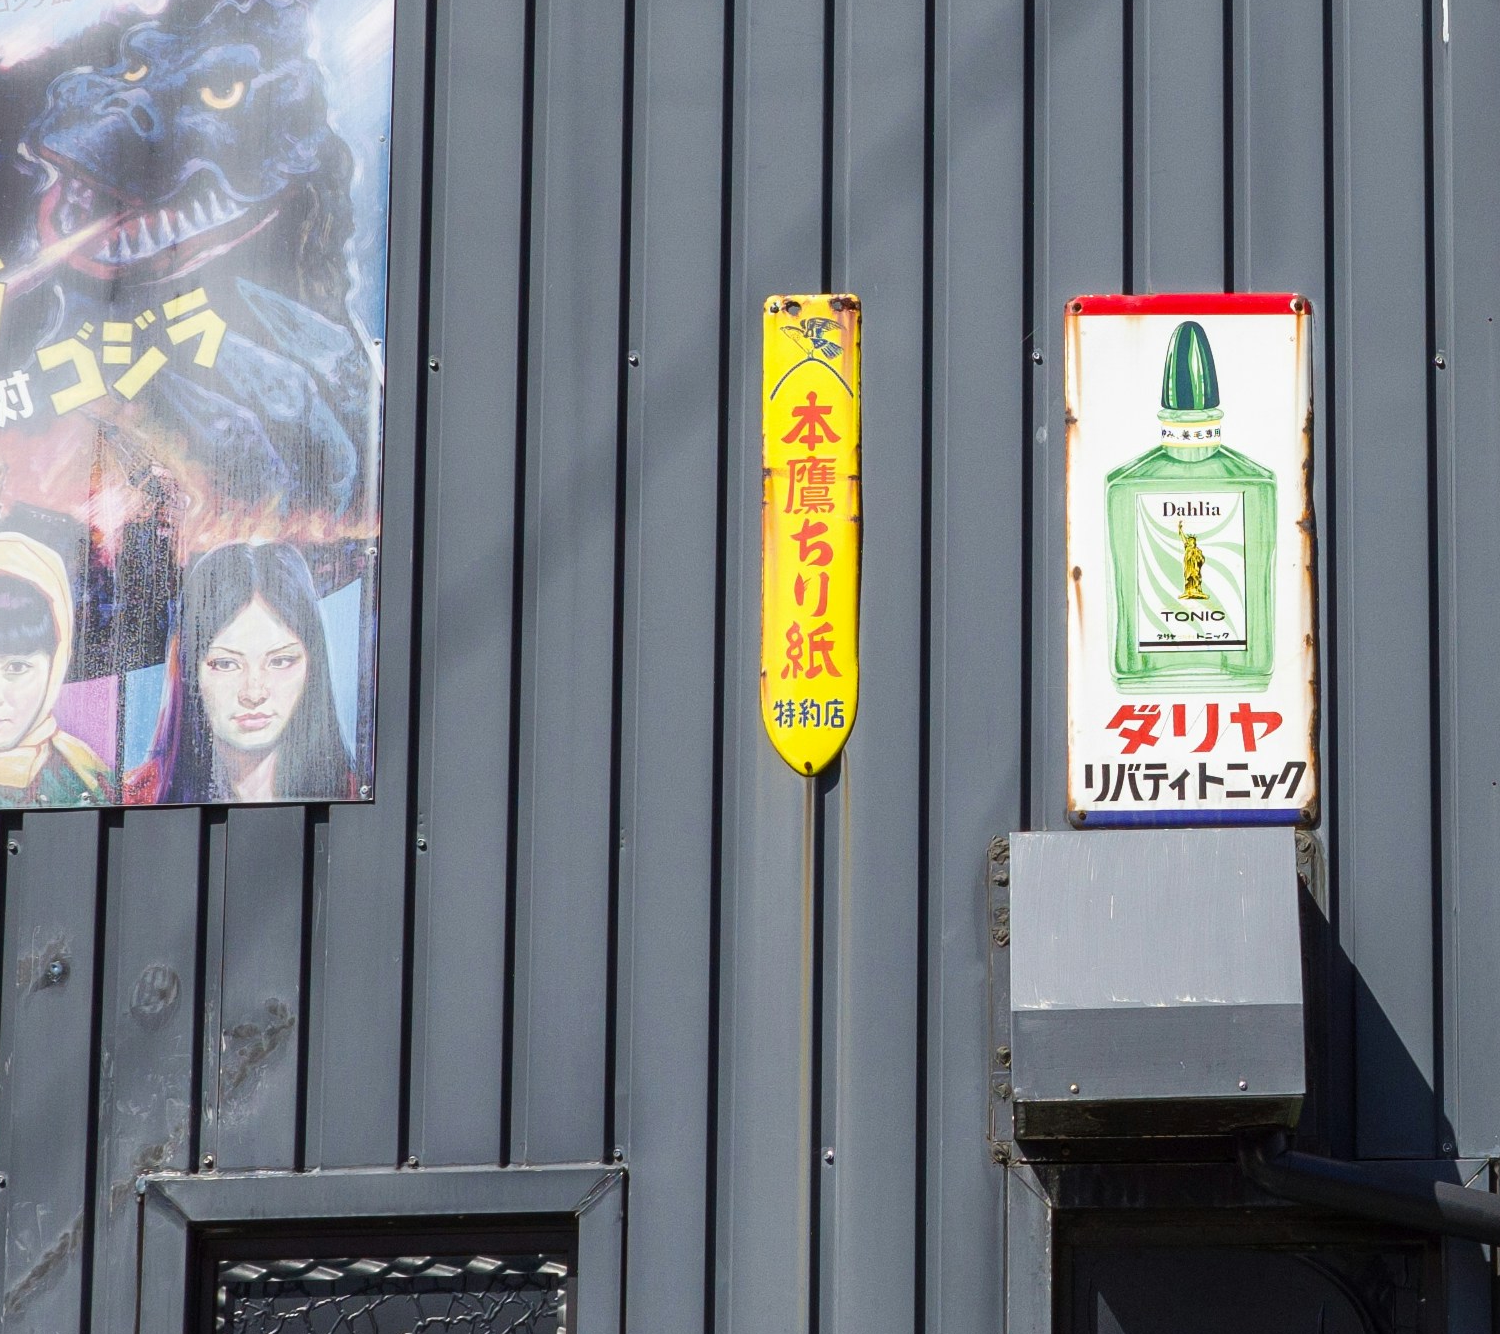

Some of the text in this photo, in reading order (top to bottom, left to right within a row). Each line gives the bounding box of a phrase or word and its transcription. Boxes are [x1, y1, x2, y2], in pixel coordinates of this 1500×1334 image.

[36, 287, 227, 416] ゴジラ
[1163, 501, 1221, 516] Dahlia
[781, 391, 842, 680] 本鷹ちり紙
[1161, 611, 1225, 622] TONIC
[773, 698, 845, 729] 特約店
[1105, 703, 1283, 754] ダリヤ
[1085, 761, 1307, 802] リバティトニック
